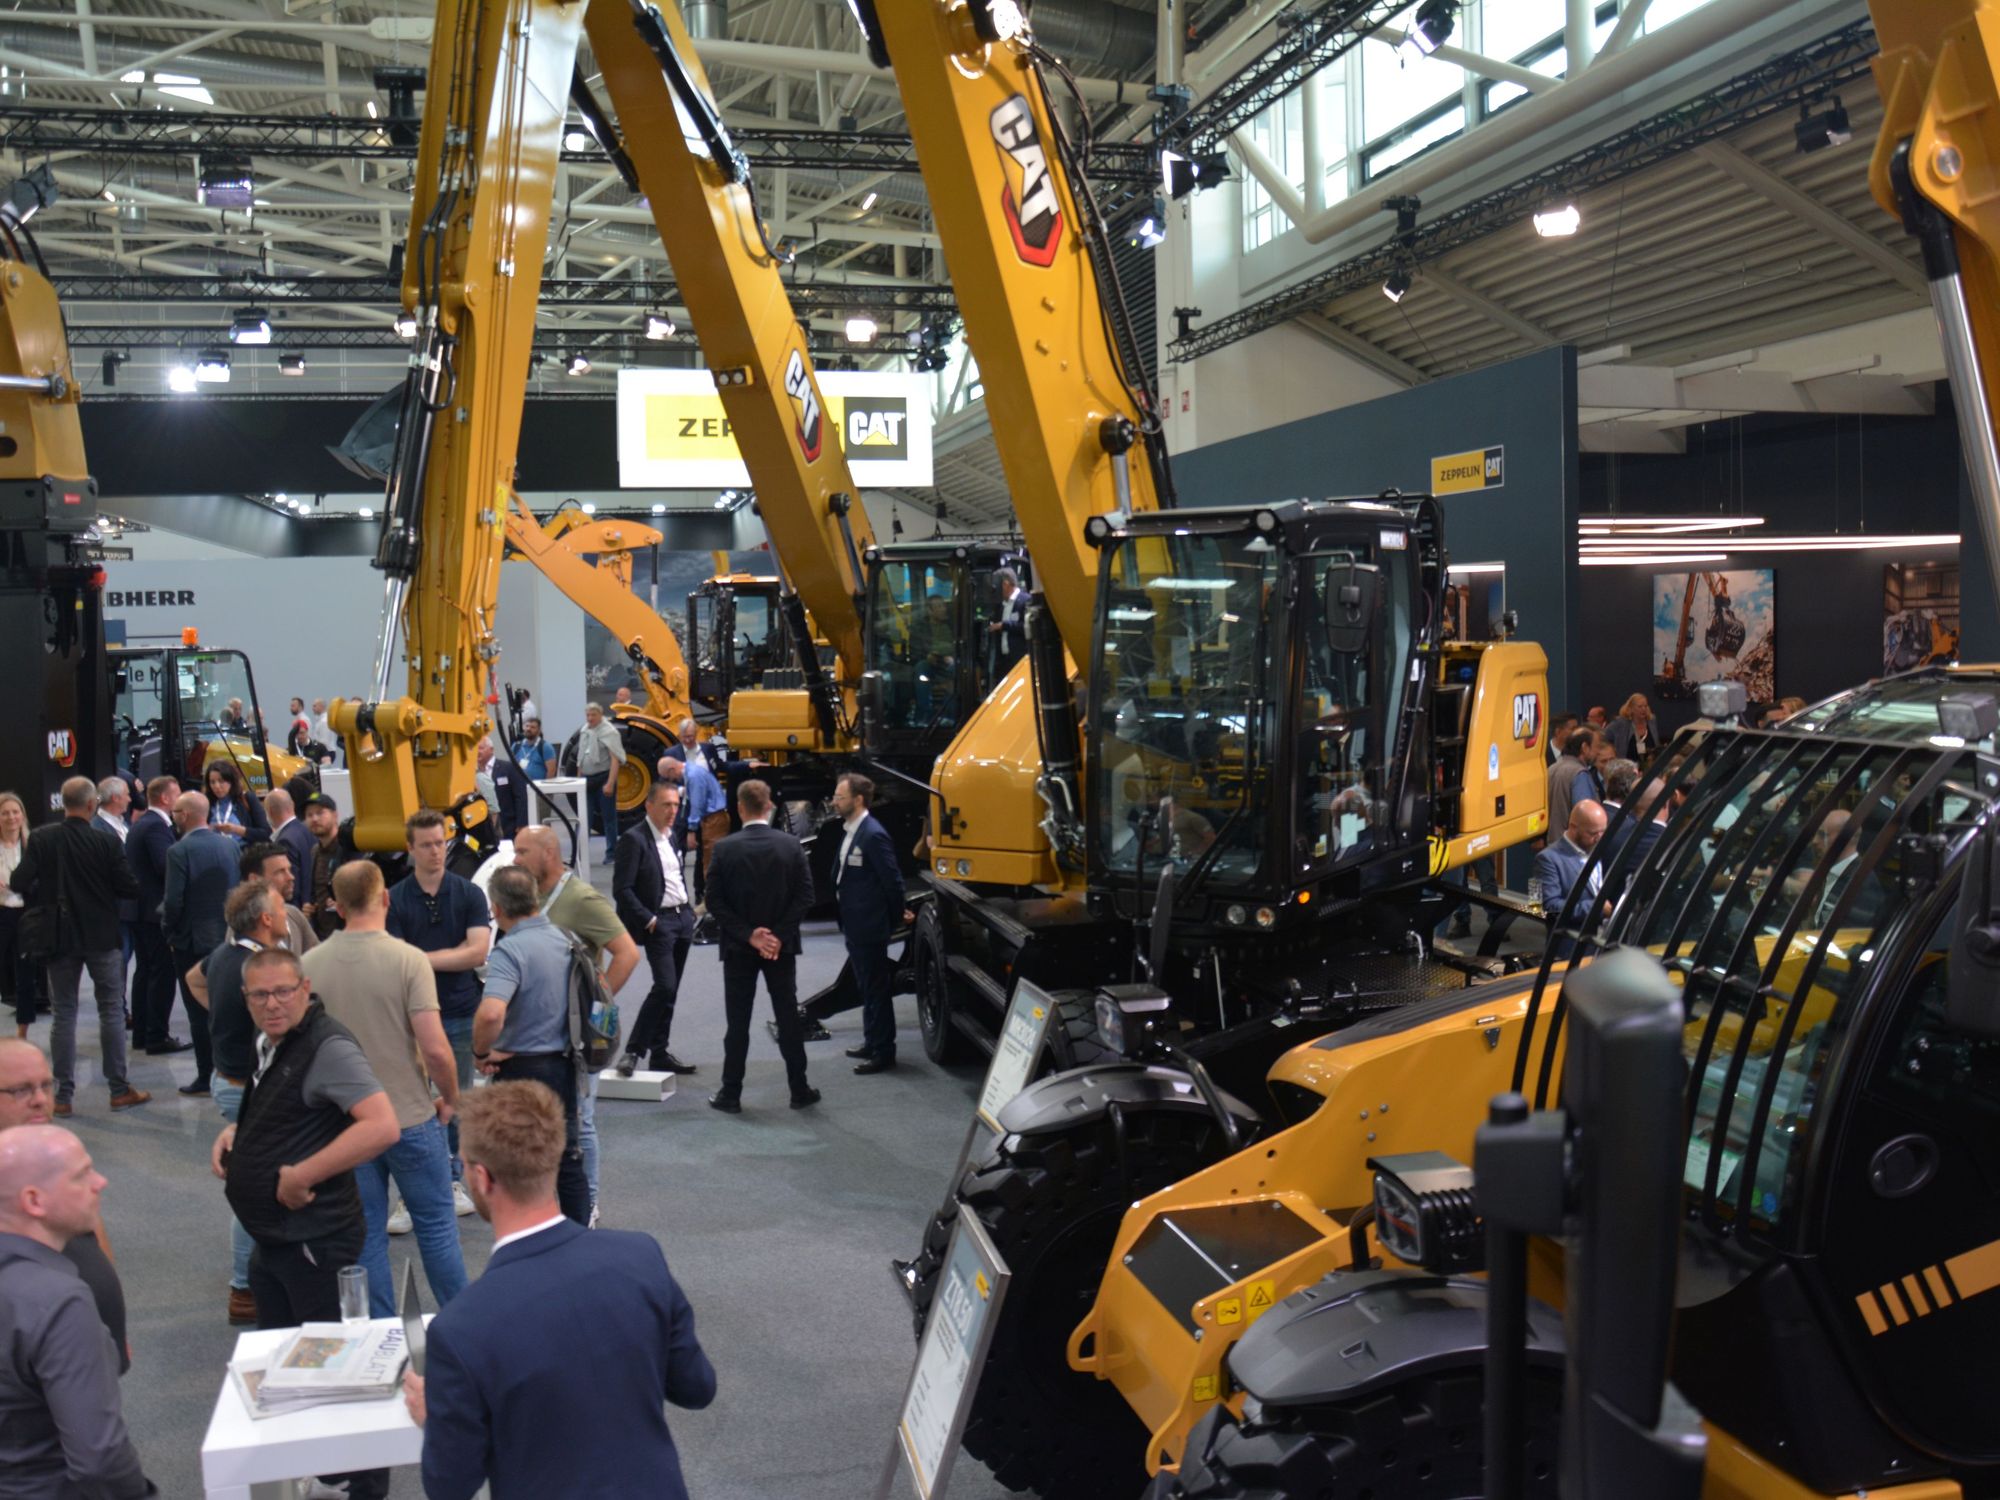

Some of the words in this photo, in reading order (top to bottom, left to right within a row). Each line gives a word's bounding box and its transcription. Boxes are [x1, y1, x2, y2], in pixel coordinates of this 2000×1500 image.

[990, 95, 1060, 227] CAT
[785, 350, 820, 440] CAT
[849, 411, 902, 446] CAT
[1440, 465, 1481, 481] ZEPPELIN
[1485, 457, 1501, 478] CAT
[106, 590, 196, 607] BHERR
[1514, 694, 1537, 738] CAT
[47, 731, 69, 759] CAT
[360, 1328, 405, 1381] BAUBLATT
